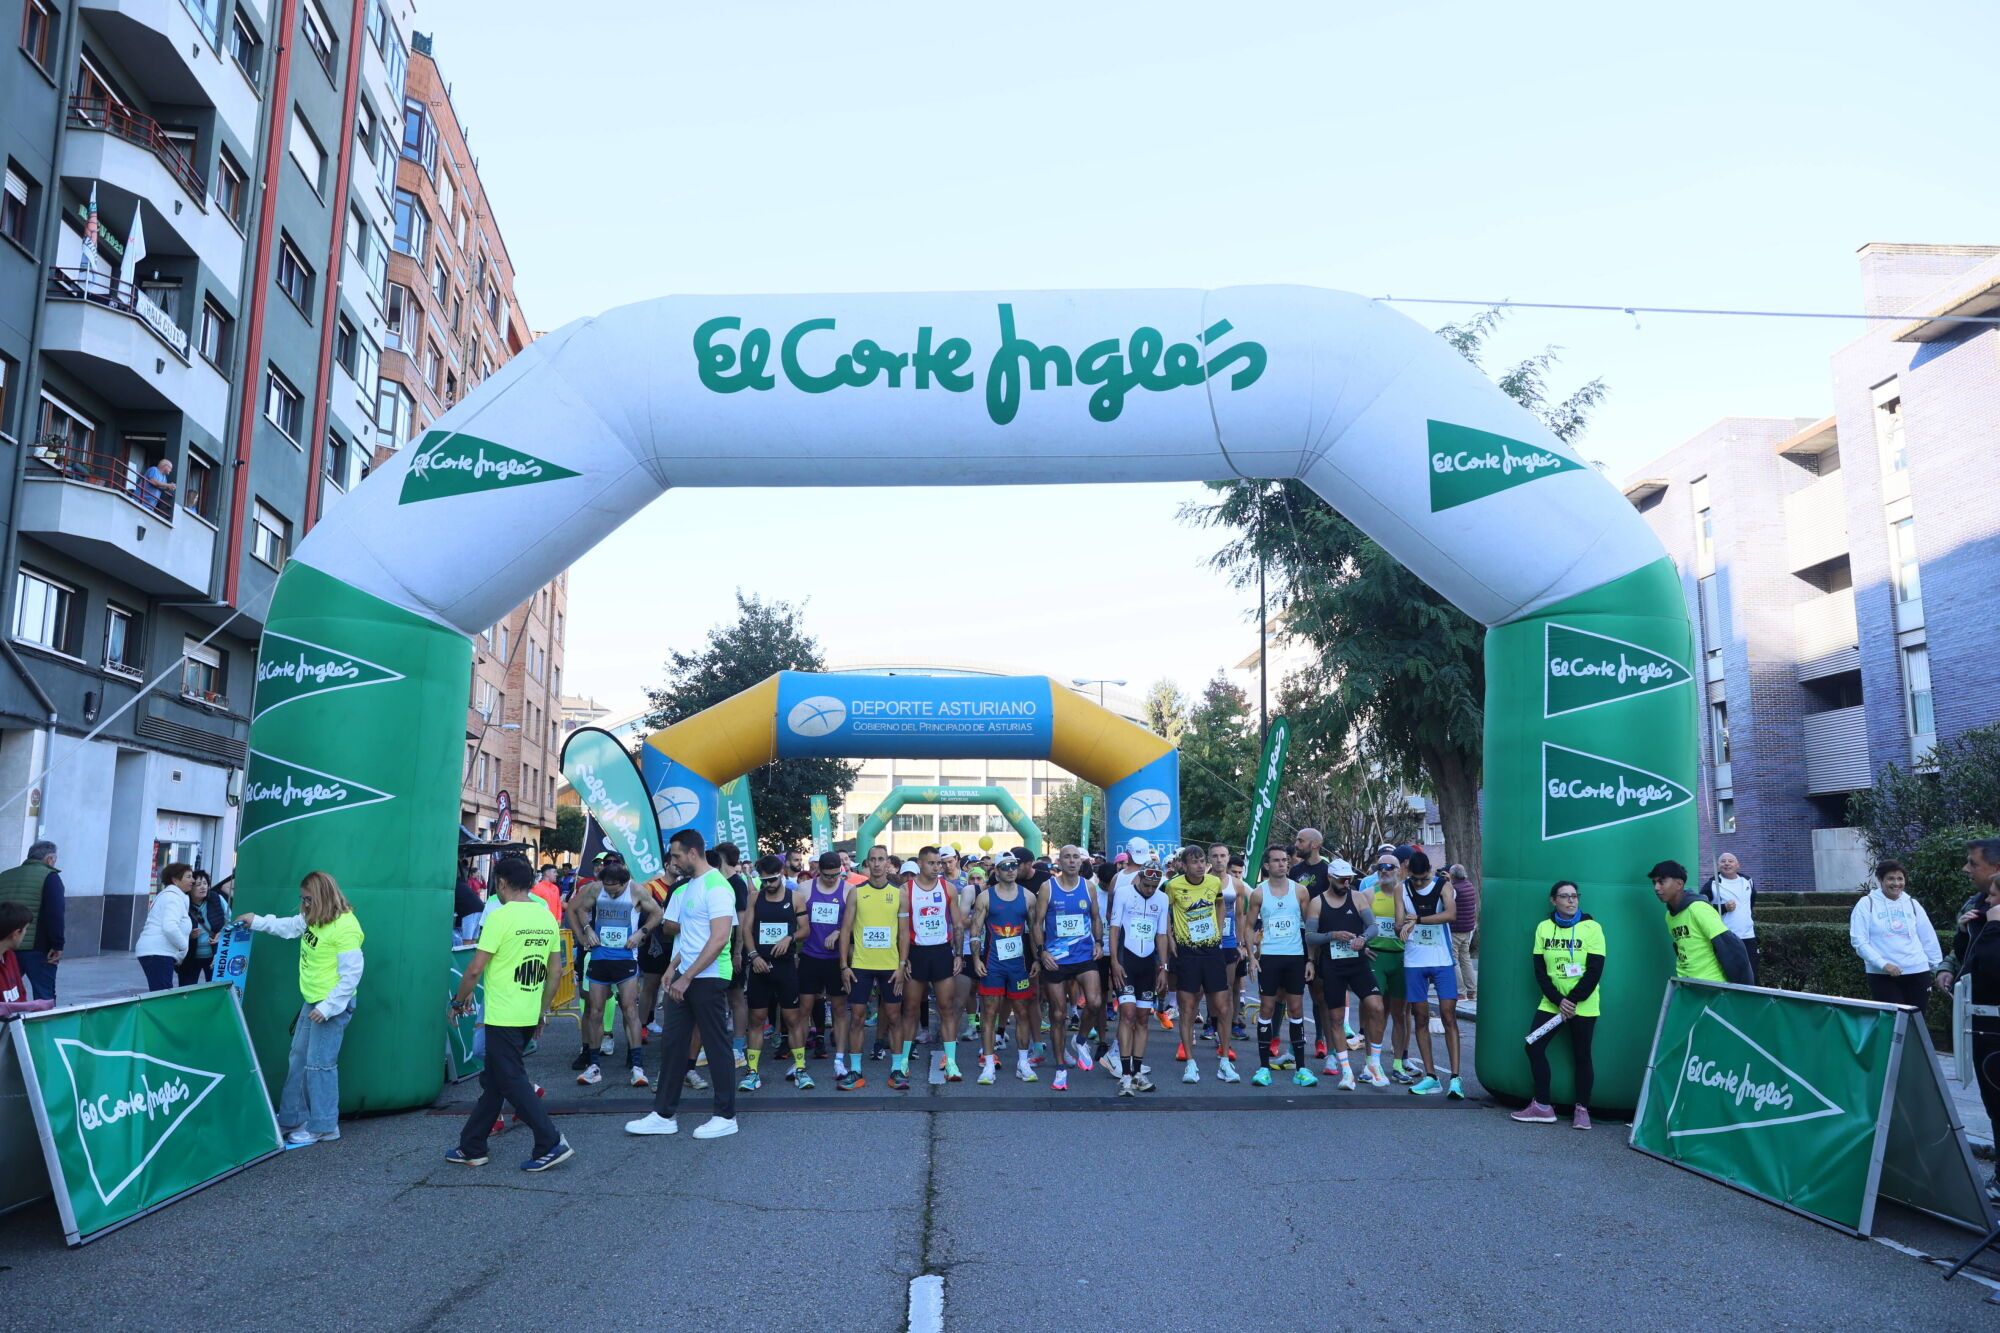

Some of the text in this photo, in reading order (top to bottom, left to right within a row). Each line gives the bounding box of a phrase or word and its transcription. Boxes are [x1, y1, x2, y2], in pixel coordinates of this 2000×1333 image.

[693, 303, 1268, 426] El Corte Inglés
[430, 452, 473, 471] Corte
[473, 448, 543, 481] Inglés
[1432, 444, 1561, 476] El Corte Inglés
[266, 660, 295, 679] Corte
[295, 653, 359, 684] Inglés
[1551, 653, 1672, 684] El Corte Inglés
[852, 701, 1036, 716] DEPORTE ASTURIANO
[853, 721, 1032, 732] GOBIERNO DEL PRINCIPADO DE ASTURIAS
[1259, 726, 1285, 809] Inglés
[253, 782, 282, 801] Corte
[282, 775, 347, 807] Inglés
[1548, 776, 1672, 807] El Corte Inglés
[818, 907, 833, 915] 244
[925, 920, 940, 928] 514
[1062, 919, 1078, 928] 387
[1136, 923, 1151, 932] 548
[1195, 922, 1210, 932] 259
[1274, 920, 1291, 929] 450
[605, 931, 622, 939] 356
[765, 928, 782, 936] 353
[868, 931, 885, 940] 243
[1421, 929, 1432, 937] 81
[1005, 941, 1016, 951] 60
[217, 949, 228, 978] MEDIA
[1686, 1055, 1793, 1112] El Corte Inglés
[80, 1074, 189, 1130] El Corte Inglés
